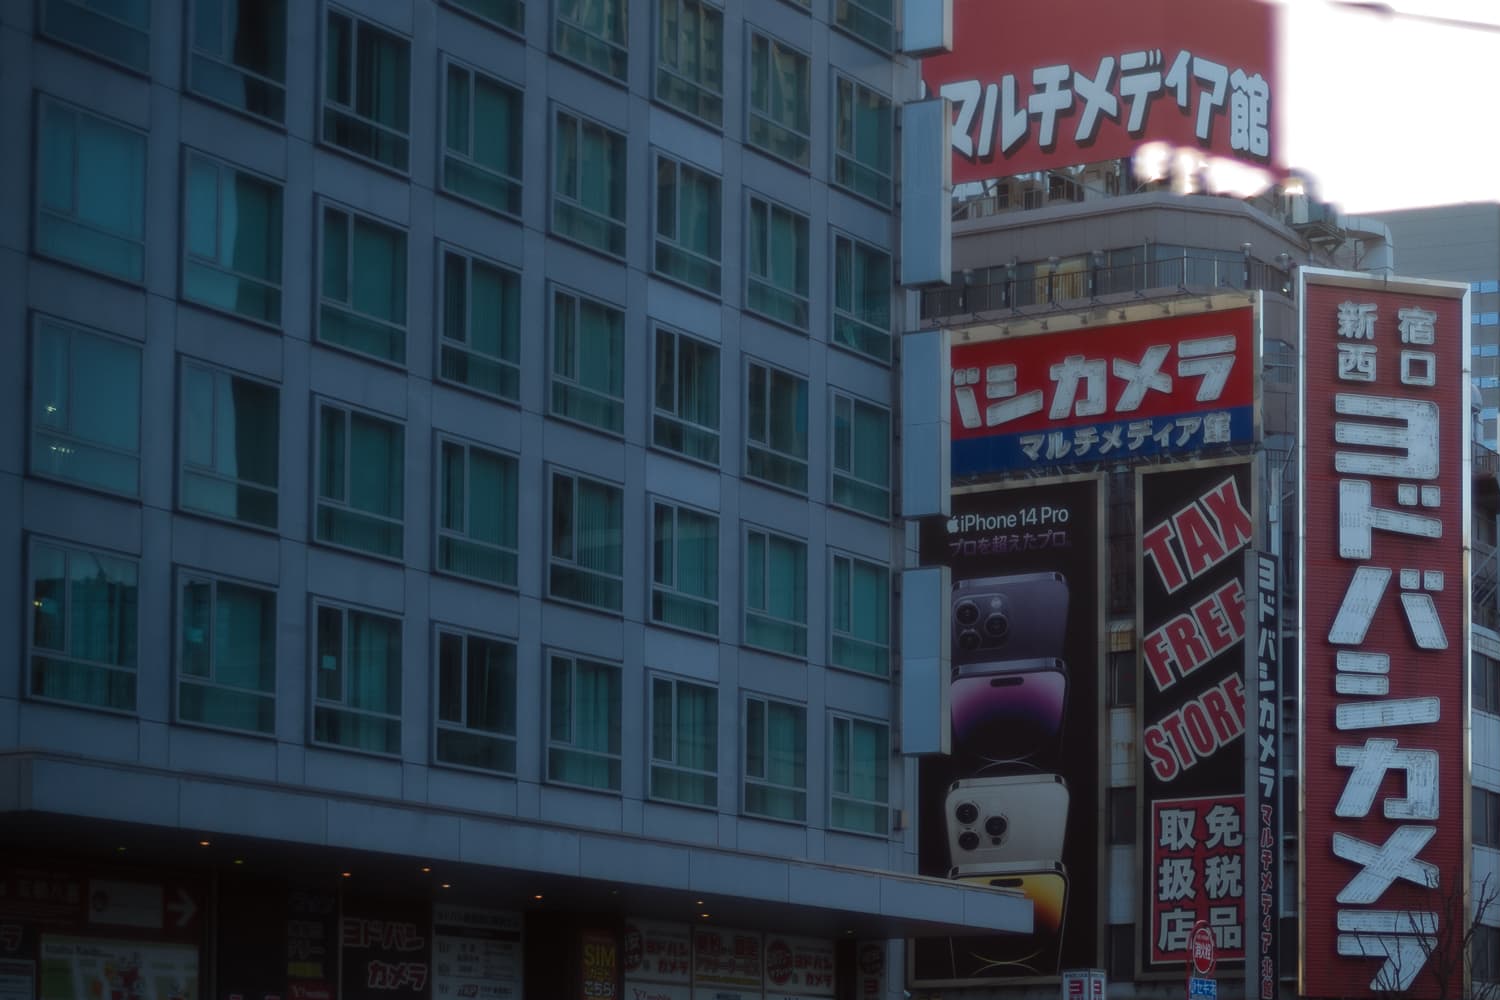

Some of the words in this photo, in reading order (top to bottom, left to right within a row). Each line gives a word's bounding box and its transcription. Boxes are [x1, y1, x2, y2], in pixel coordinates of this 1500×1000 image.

[940, 49, 1270, 158] マルチメディア館
[1336, 302, 1437, 346] 新宿
[1337, 343, 1437, 387] 西口
[1019, 411, 1232, 461] マルチメディア館
[960, 512, 1017, 533] iPhone
[1019, 507, 1038, 526] 14
[1041, 506, 1069, 525] Pro
[1143, 475, 1252, 595] TAX
[1258, 556, 1276, 798] ヨドバシカメラ
[1328, 393, 1449, 992] ヨドバシカメラ
[1158, 807, 1196, 952] 取扱店
[1205, 804, 1244, 950] 免税品
[368, 960, 428, 991] カメラ
[584, 943, 616, 968] SIM
